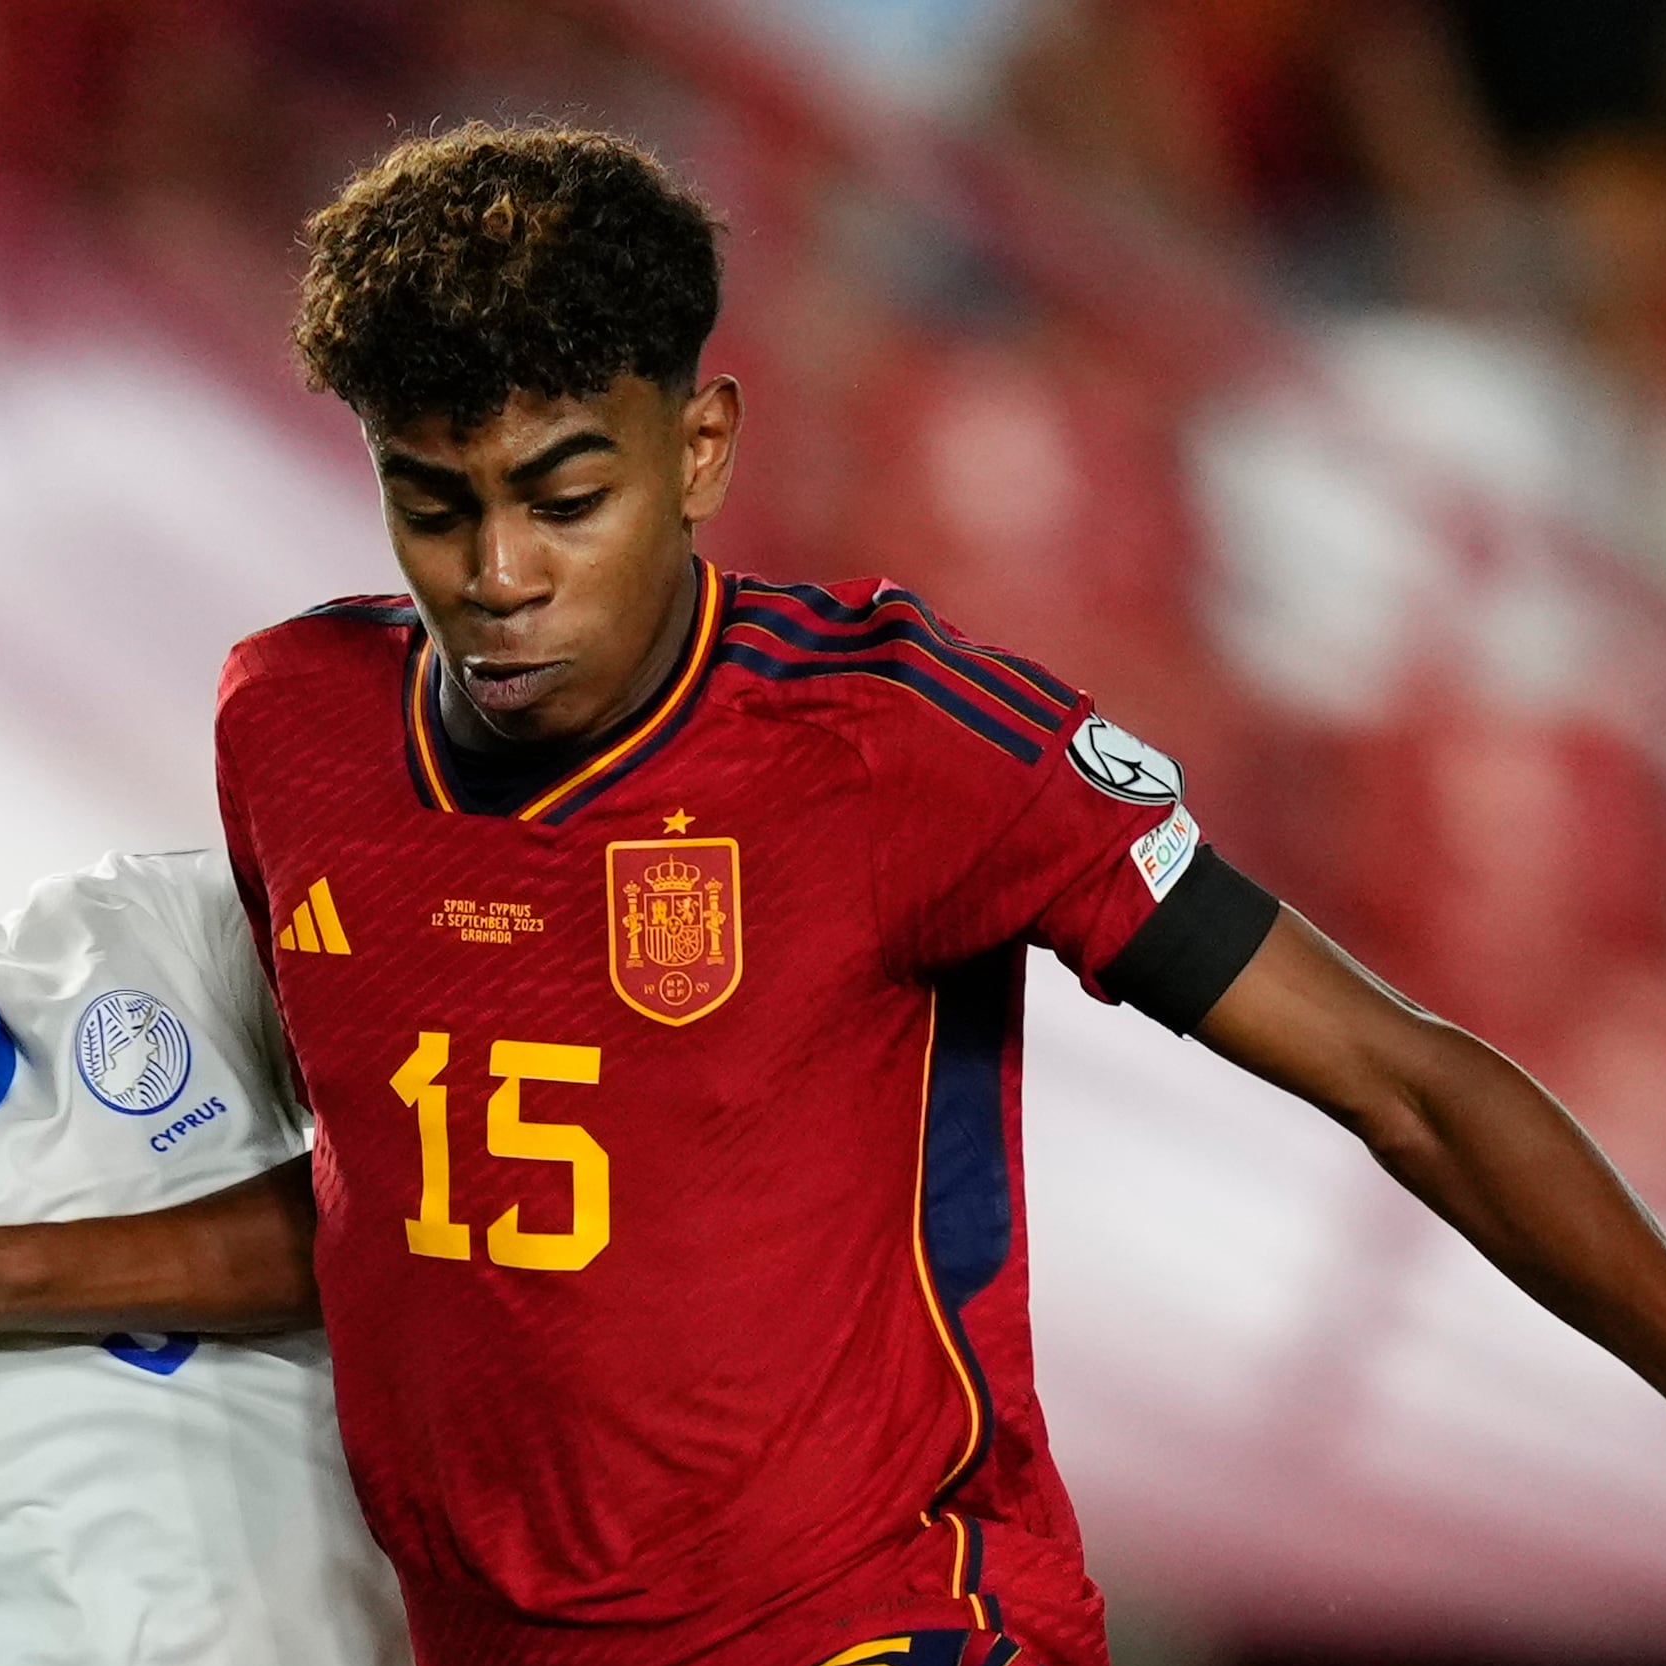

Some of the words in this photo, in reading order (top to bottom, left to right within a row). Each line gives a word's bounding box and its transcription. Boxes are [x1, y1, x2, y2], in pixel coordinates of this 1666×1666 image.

[444, 899, 475, 914] SPAIN
[489, 902, 531, 918] CYPRUS
[431, 913, 444, 927] 12
[447, 914, 509, 931] SEPTEMBER
[513, 918, 544, 932] 2023
[461, 928, 512, 945] GRANADA
[149, 1096, 228, 1154] CYPRUS
[389, 1031, 610, 1271] 15
